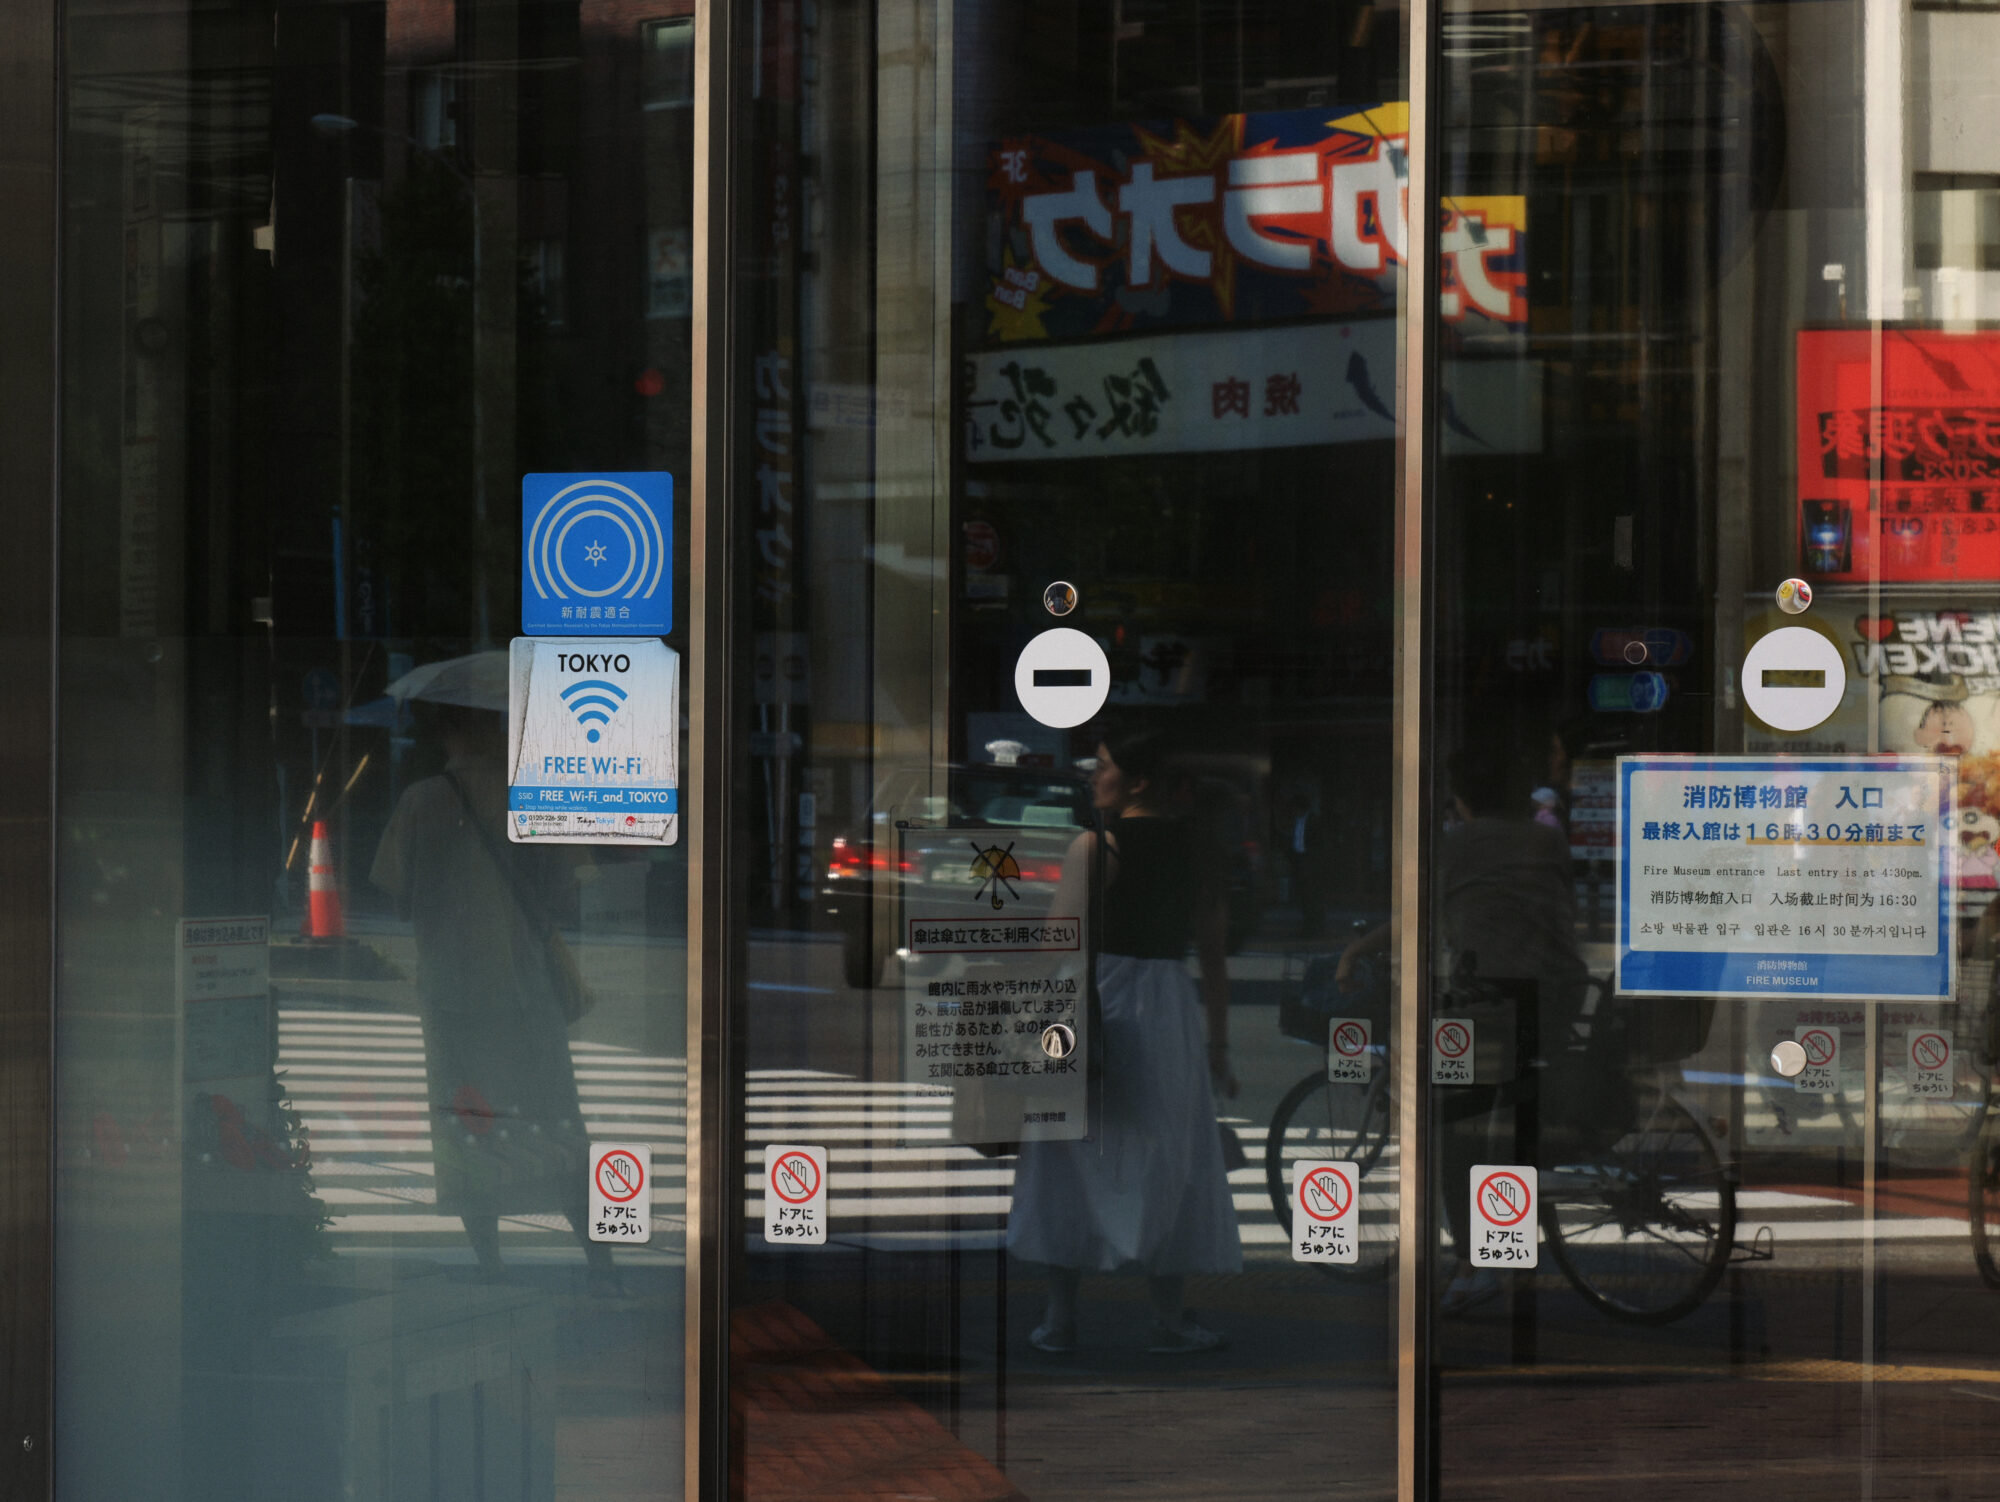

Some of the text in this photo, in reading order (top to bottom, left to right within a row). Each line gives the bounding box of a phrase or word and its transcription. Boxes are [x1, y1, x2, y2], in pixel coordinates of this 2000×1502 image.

[561, 606, 631, 619] 新耐震適合
[558, 653, 631, 673] TOKYO
[544, 756, 641, 775] FREE Wi-Fi
[518, 792, 533, 800] SSID
[1683, 785, 1884, 809] 消防博物館 入口
[1644, 866, 1923, 879] Fire Museum entrance Last entry is at 4:30pm.
[1650, 890, 1752, 905] 消防博物館入口
[914, 927, 1076, 945] 傘は傘立てをご利用ください
[1640, 923, 1664, 935] 소방
[1672, 922, 1709, 935] 박물관
[1716, 923, 1740, 936] 입구
[1754, 923, 1791, 936] 입관은
[928, 979, 1077, 996] 館内に雨水や汚れが入り込
[1746, 975, 1818, 986] FIRE MUSEUM
[915, 1042, 1002, 1058] みはできません。
[928, 1058, 1078, 1078] 玄関にある傘立てをご利用く
[1338, 1059, 1363, 1068] ドアに
[1440, 1060, 1465, 1069] ドアに
[1333, 1069, 1366, 1079] ちゅうい
[1436, 1070, 1469, 1080] ちゅうい
[602, 1206, 637, 1219] ドアに
[778, 1207, 814, 1221] ドアに
[596, 1221, 642, 1236] ちゅうい
[772, 1223, 819, 1237] ちゅうい
[1307, 1225, 1345, 1239] ドアに
[1485, 1230, 1524, 1244] ドアに
[1300, 1241, 1350, 1256] ちゅうい
[1478, 1247, 1529, 1261] ちゅうい
